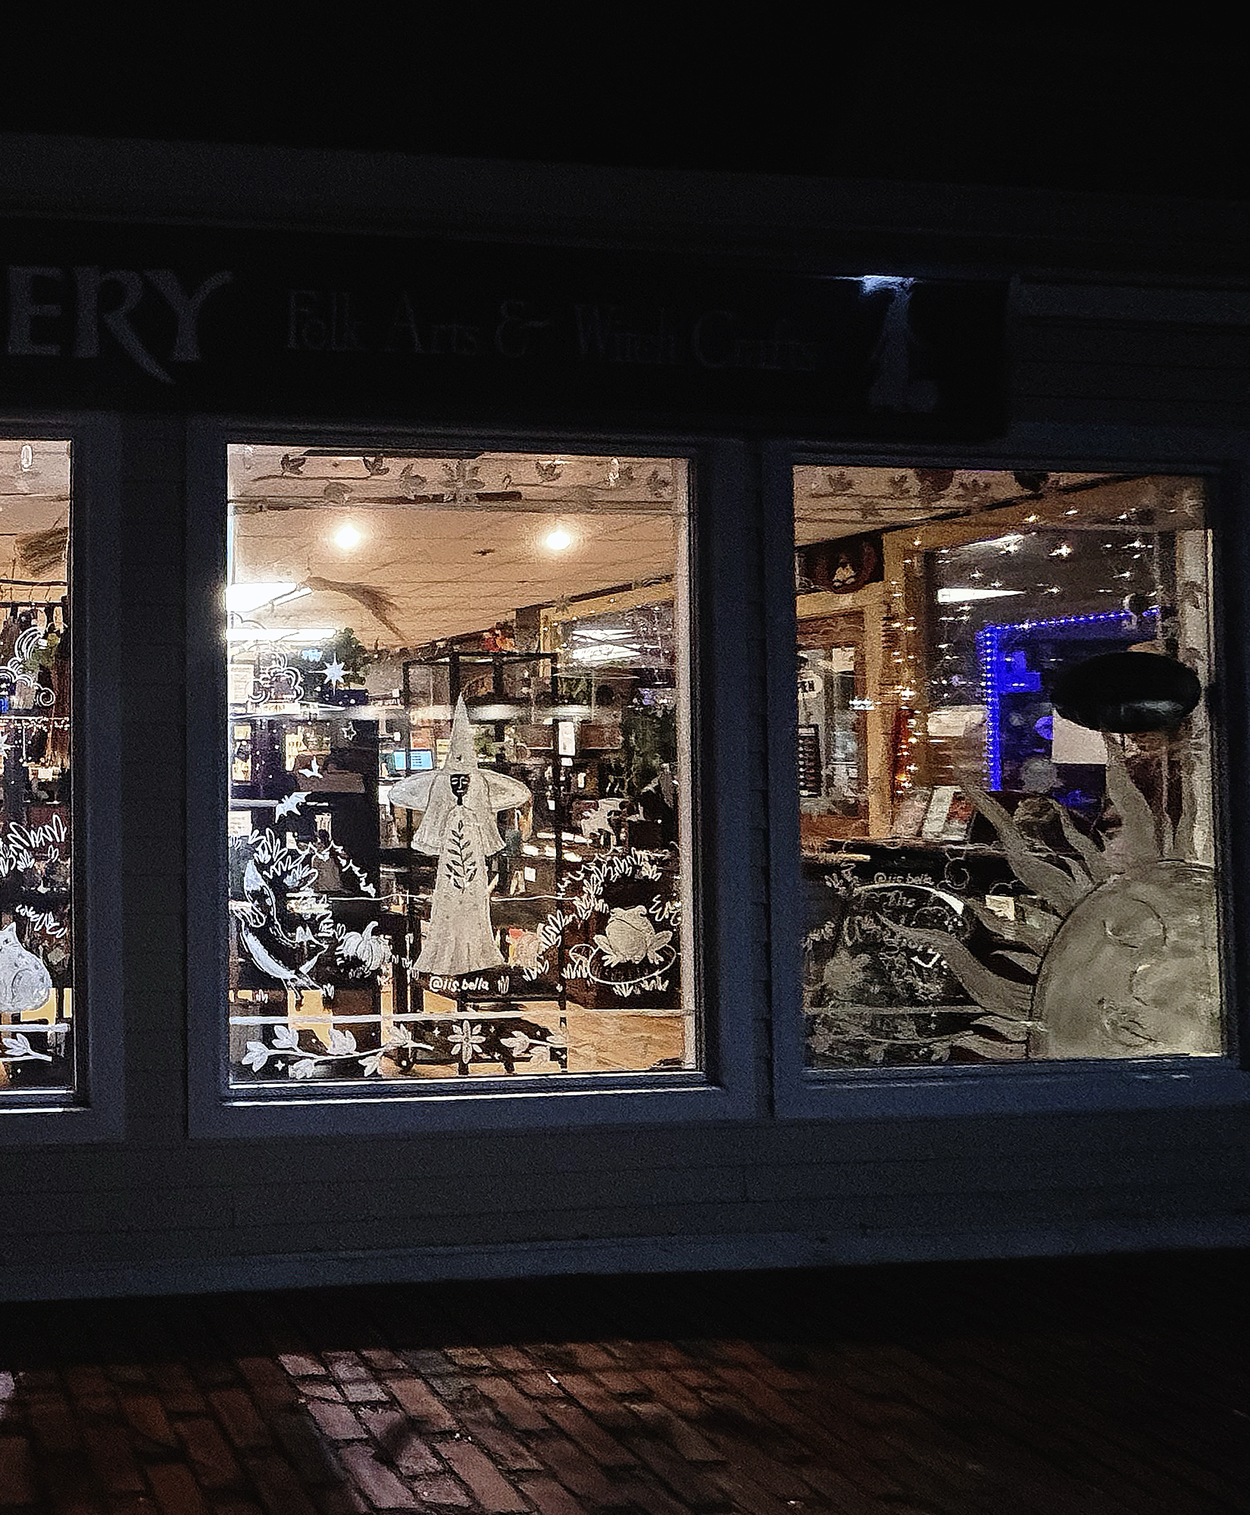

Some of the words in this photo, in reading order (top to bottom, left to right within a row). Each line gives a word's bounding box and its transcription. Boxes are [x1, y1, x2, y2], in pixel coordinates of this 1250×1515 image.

[288, 289, 366, 353] Folk
[383, 290, 480, 357] Arts
[496, 298, 551, 359] &
[573, 303, 679, 366] Witch
[690, 308, 820, 373] Crafts
